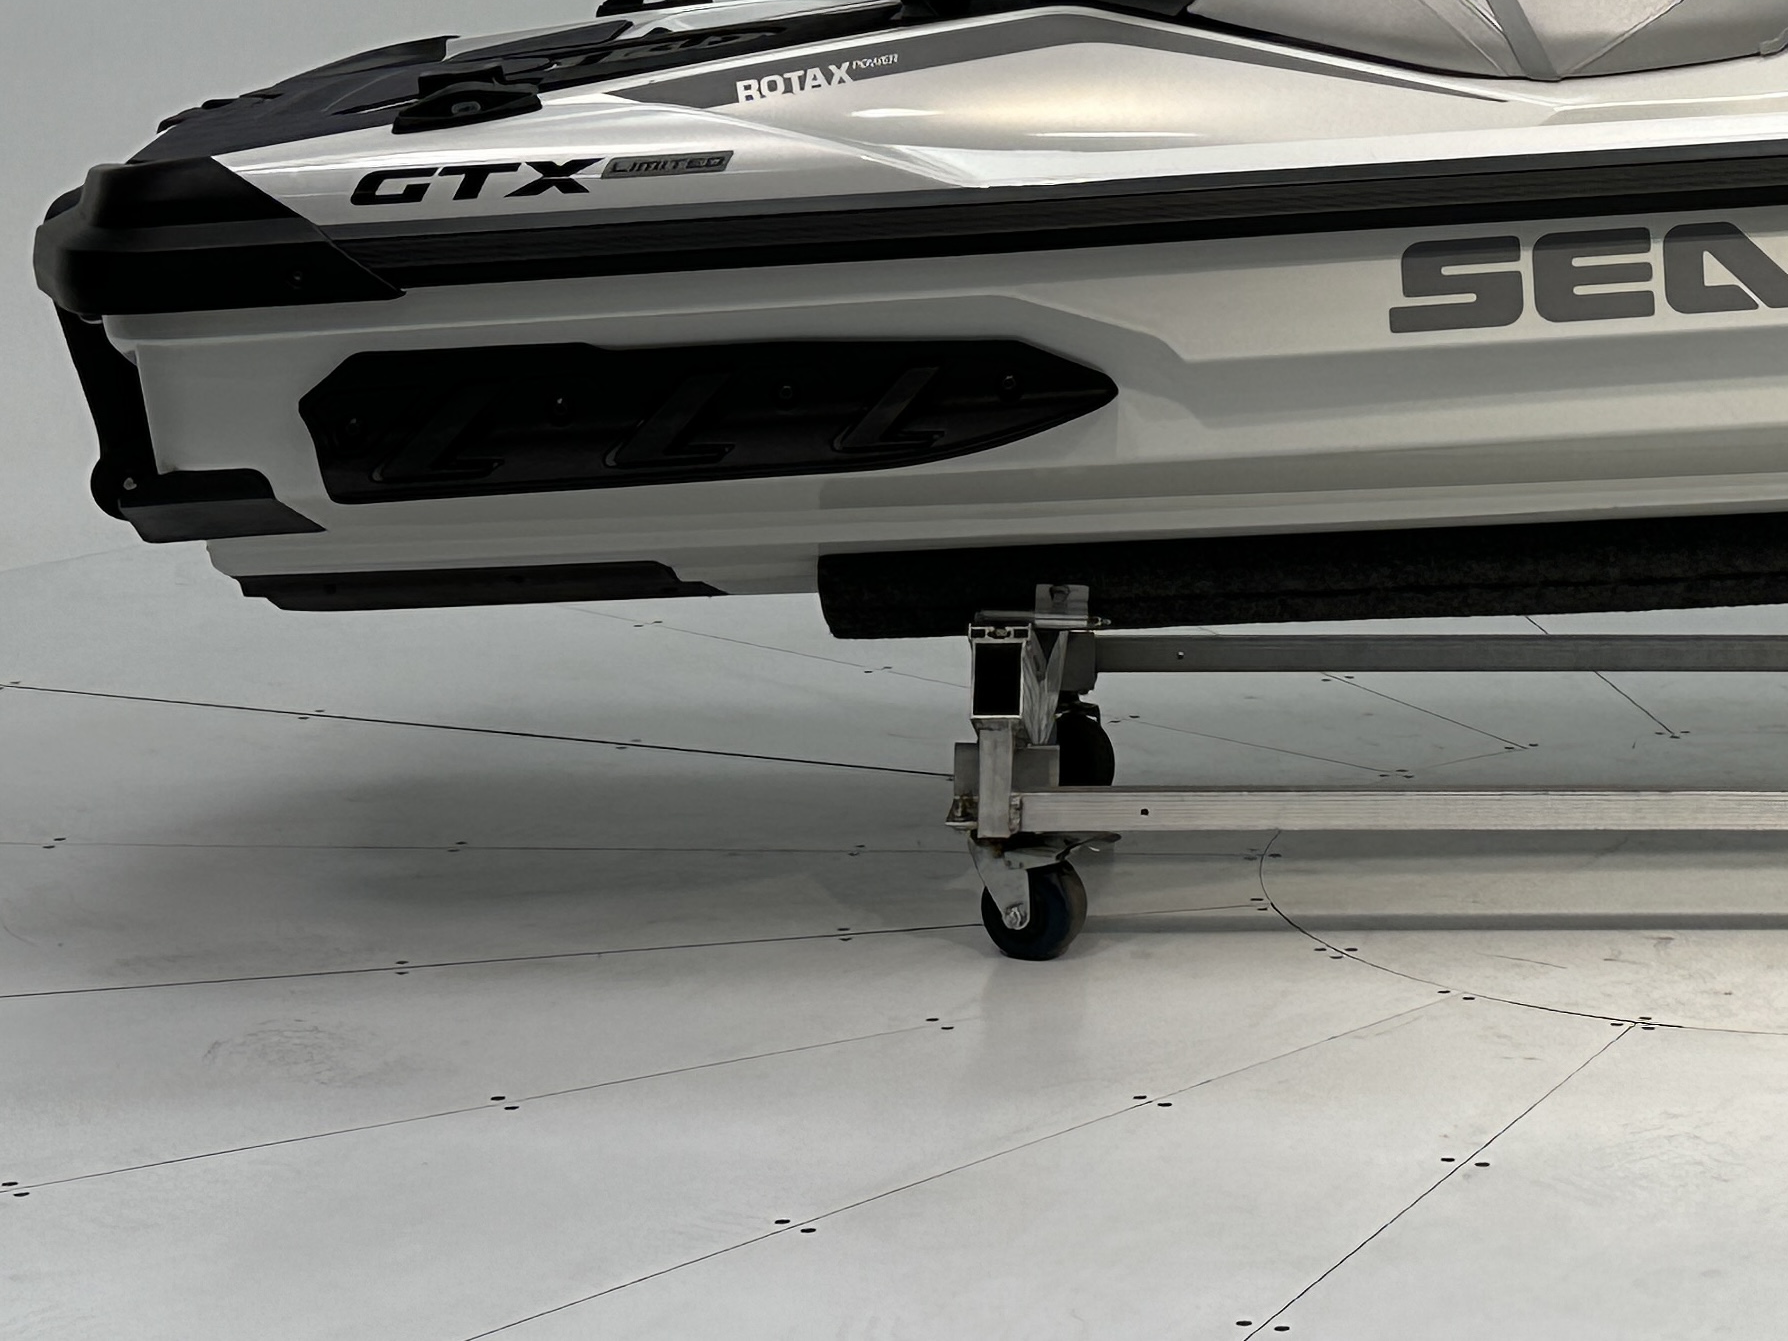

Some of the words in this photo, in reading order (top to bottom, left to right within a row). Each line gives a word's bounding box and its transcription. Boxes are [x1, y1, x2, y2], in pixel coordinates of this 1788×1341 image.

[736, 61, 854, 103] ROTAX
[350, 157, 606, 206] GTX
[610, 157, 724, 173] LIMITED
